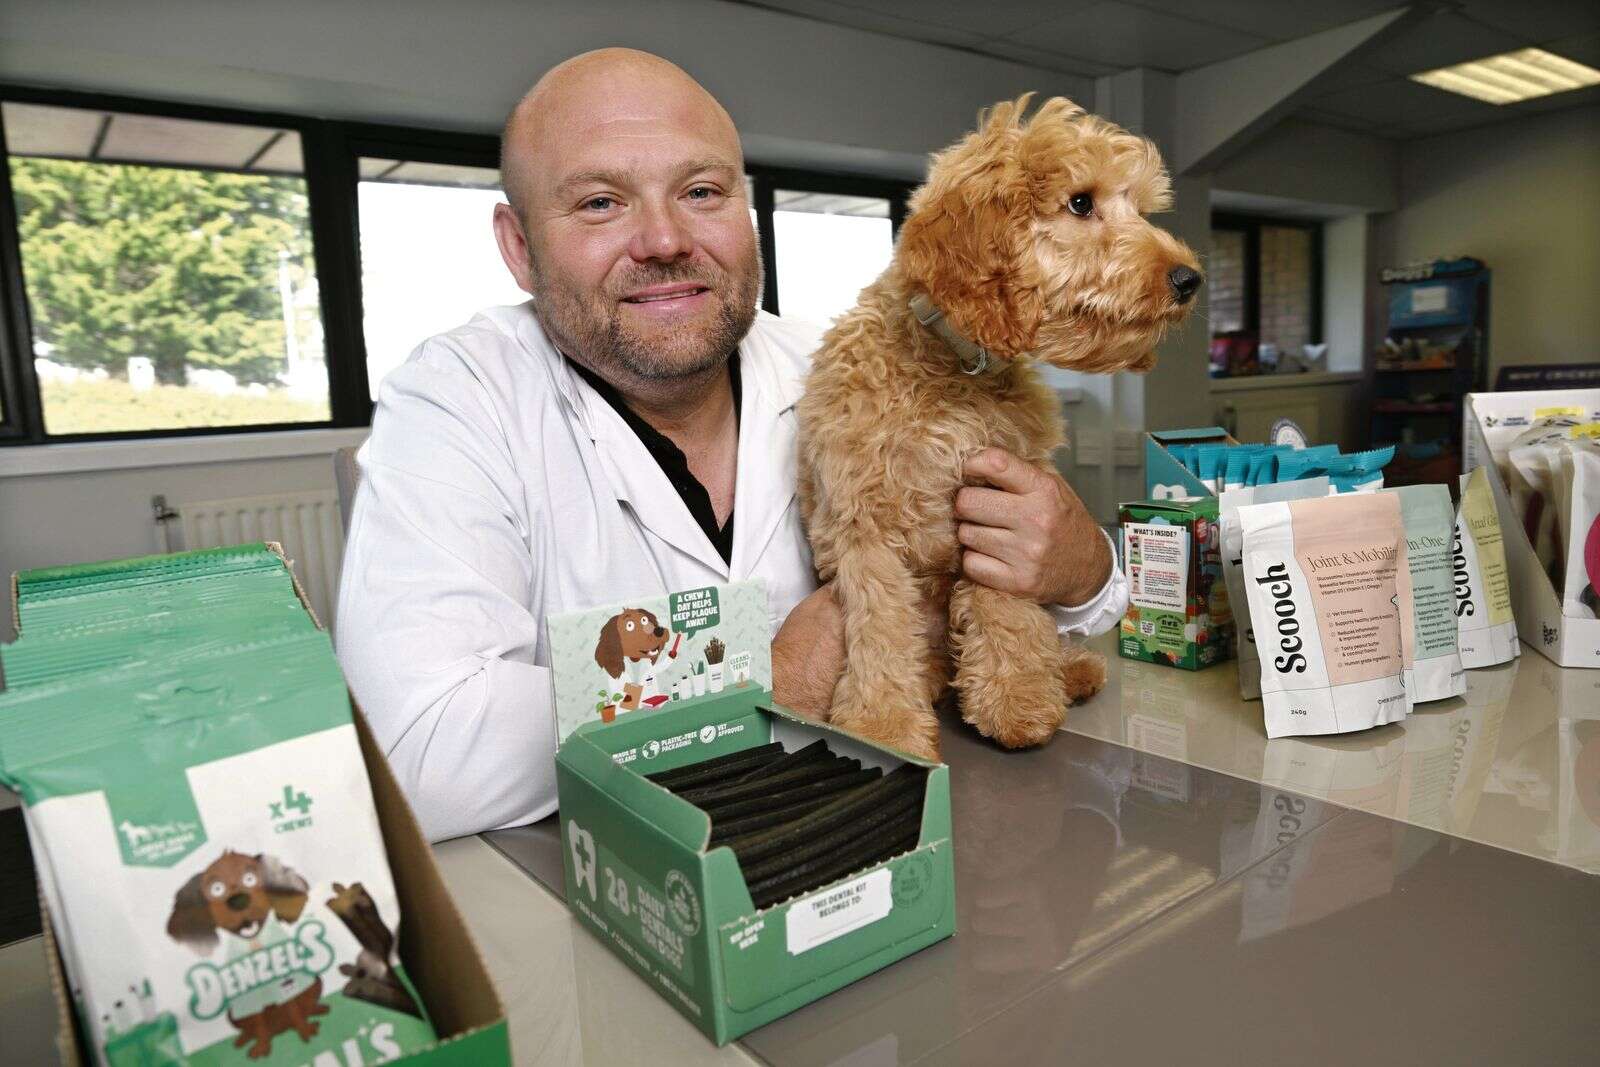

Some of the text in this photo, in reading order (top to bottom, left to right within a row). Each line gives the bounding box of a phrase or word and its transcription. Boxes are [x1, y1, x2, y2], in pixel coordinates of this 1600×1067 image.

[1133, 528, 1177, 538] WHAT'S INSIDE?
[1307, 554, 1341, 573] Joint
[1341, 552, 1355, 565] &
[677, 589, 711, 603] A CHEW A
[677, 599, 712, 612] DAY HELPS
[672, 606, 718, 621] KEEP PLAQUE
[1256, 562, 1306, 673] Scooch
[686, 617, 707, 628] AWAY!
[660, 731, 698, 746] PLASTIC-FREE
[718, 725, 744, 737] APPROVED
[661, 739, 692, 753] PACKAGING
[269, 785, 313, 819] x4
[605, 866, 630, 916] 28
[812, 882, 867, 911] THIS DENTAL KIT
[819, 900, 850, 919] BELONGS
